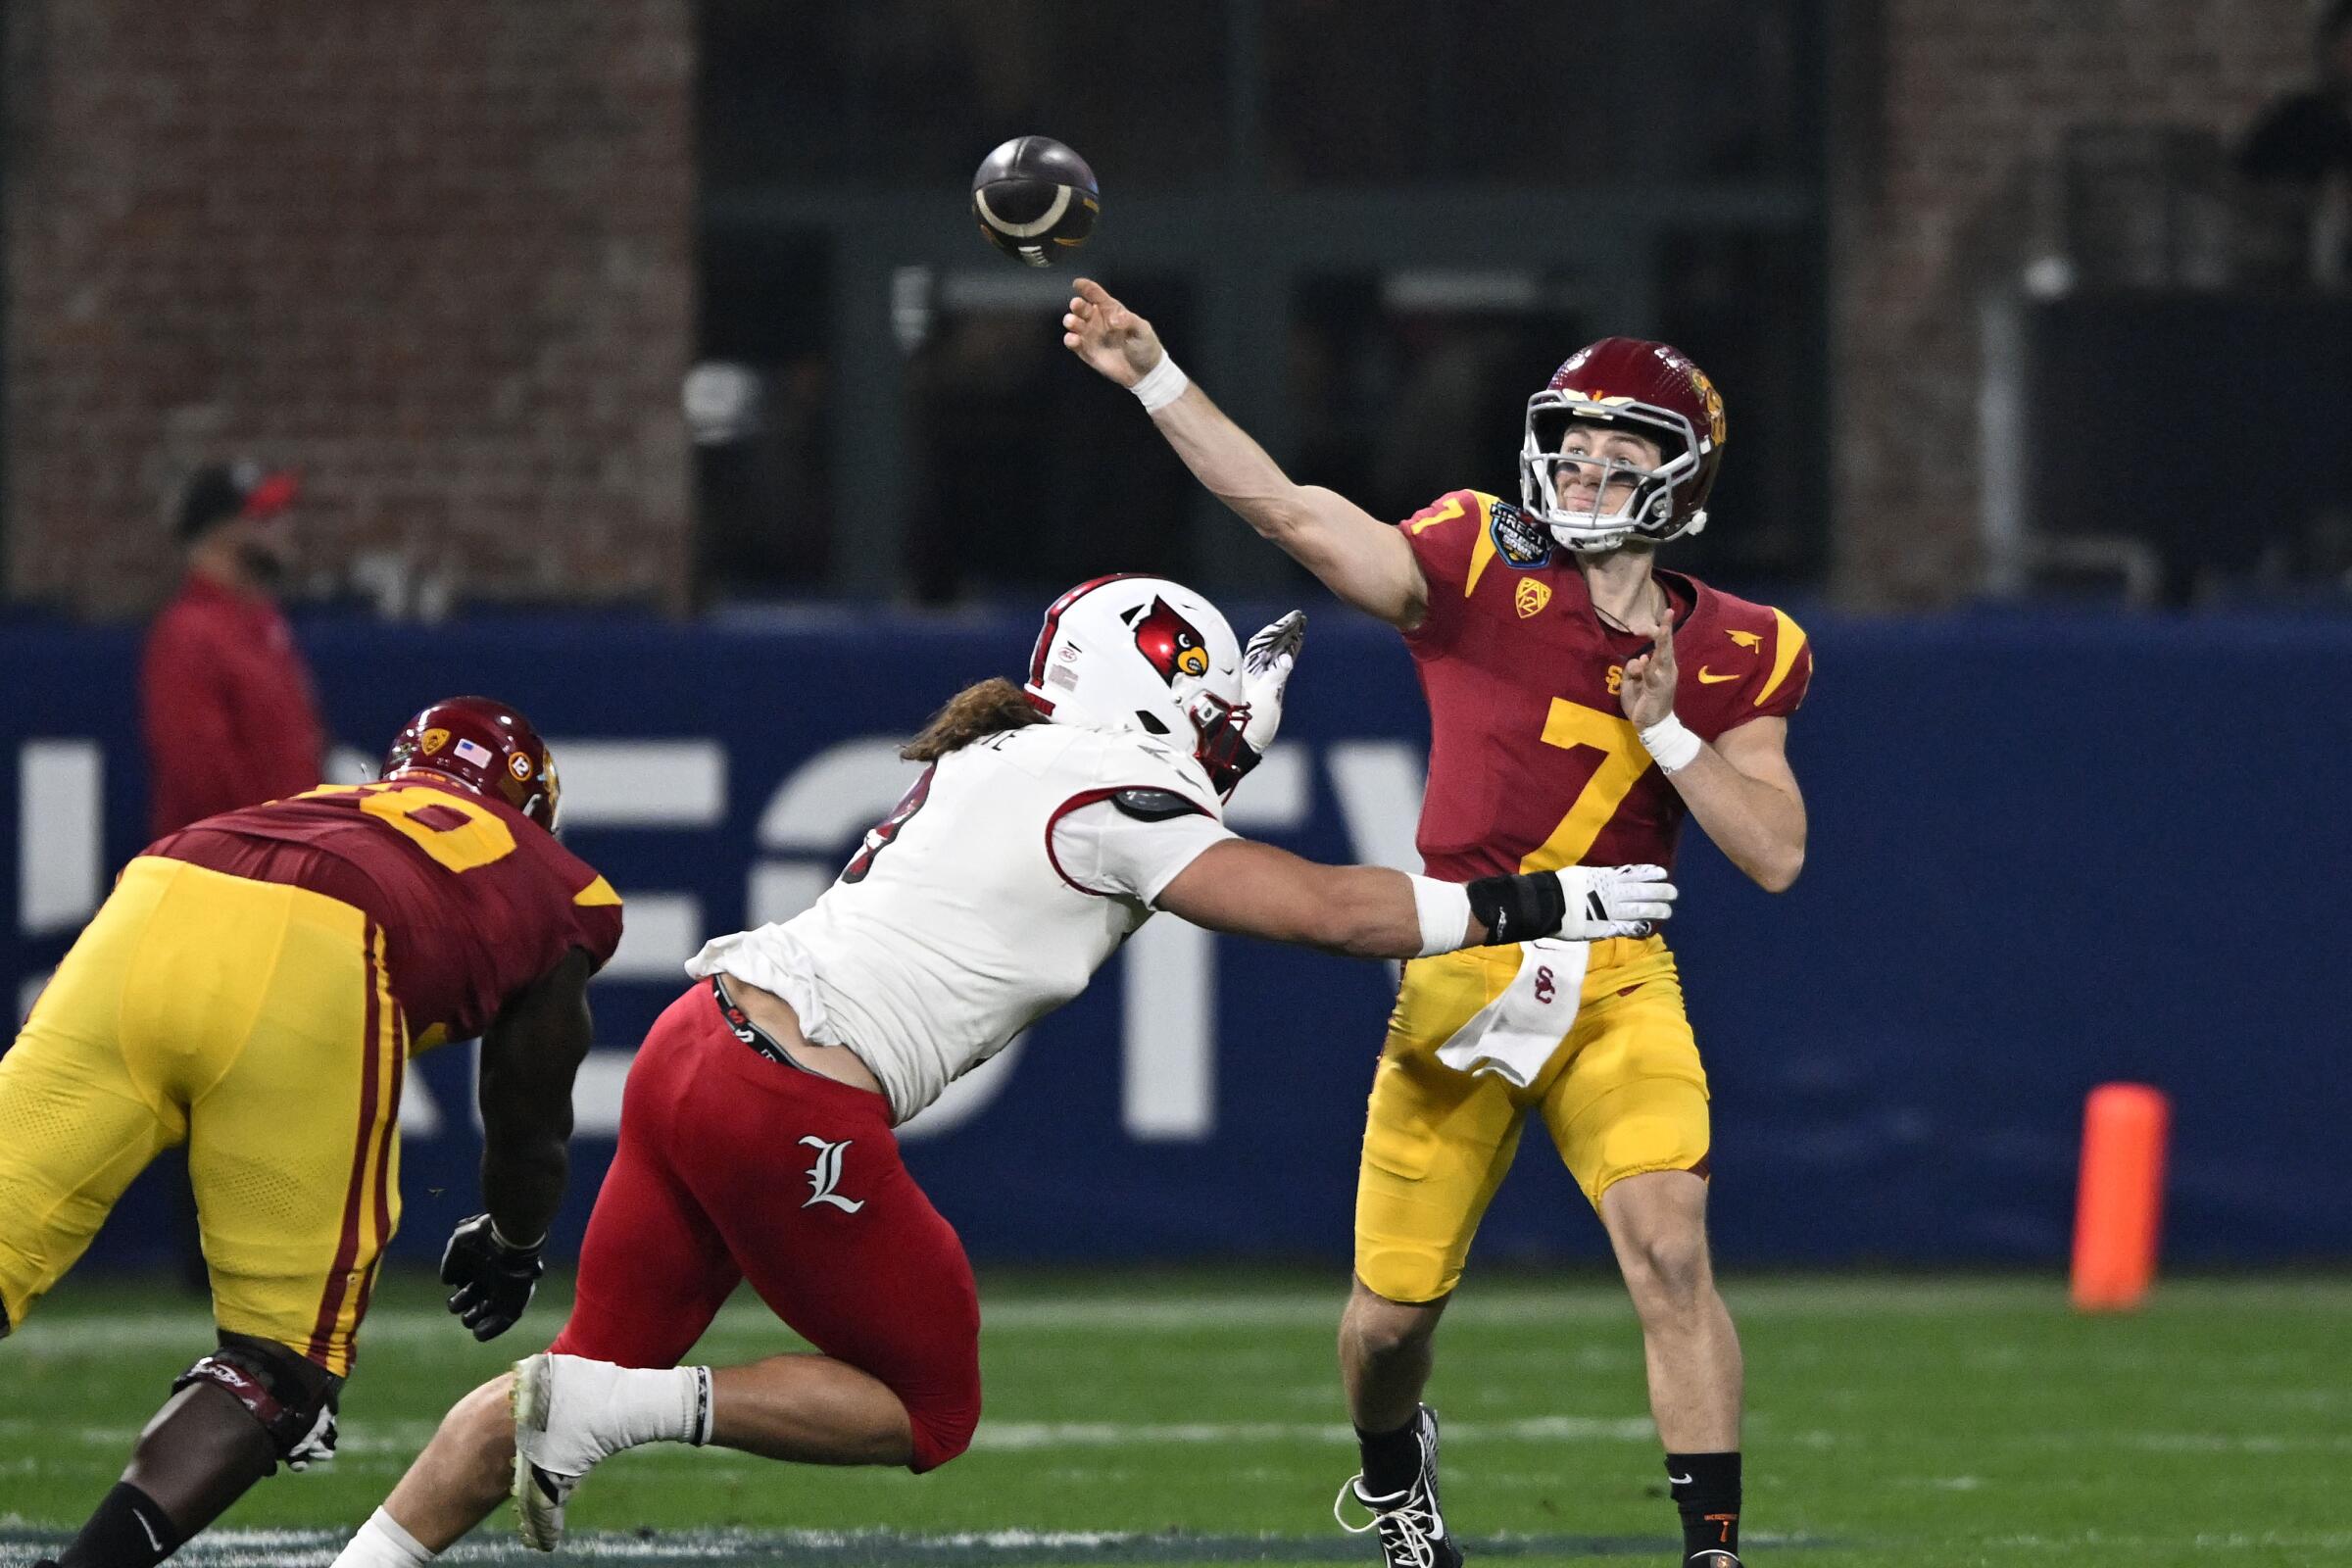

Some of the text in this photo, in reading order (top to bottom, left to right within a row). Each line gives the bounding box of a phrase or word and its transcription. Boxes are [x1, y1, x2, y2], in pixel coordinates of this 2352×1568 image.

[1410, 498, 1465, 535] 7
[1519, 697, 1655, 876] 7
[798, 1135, 865, 1214] L
